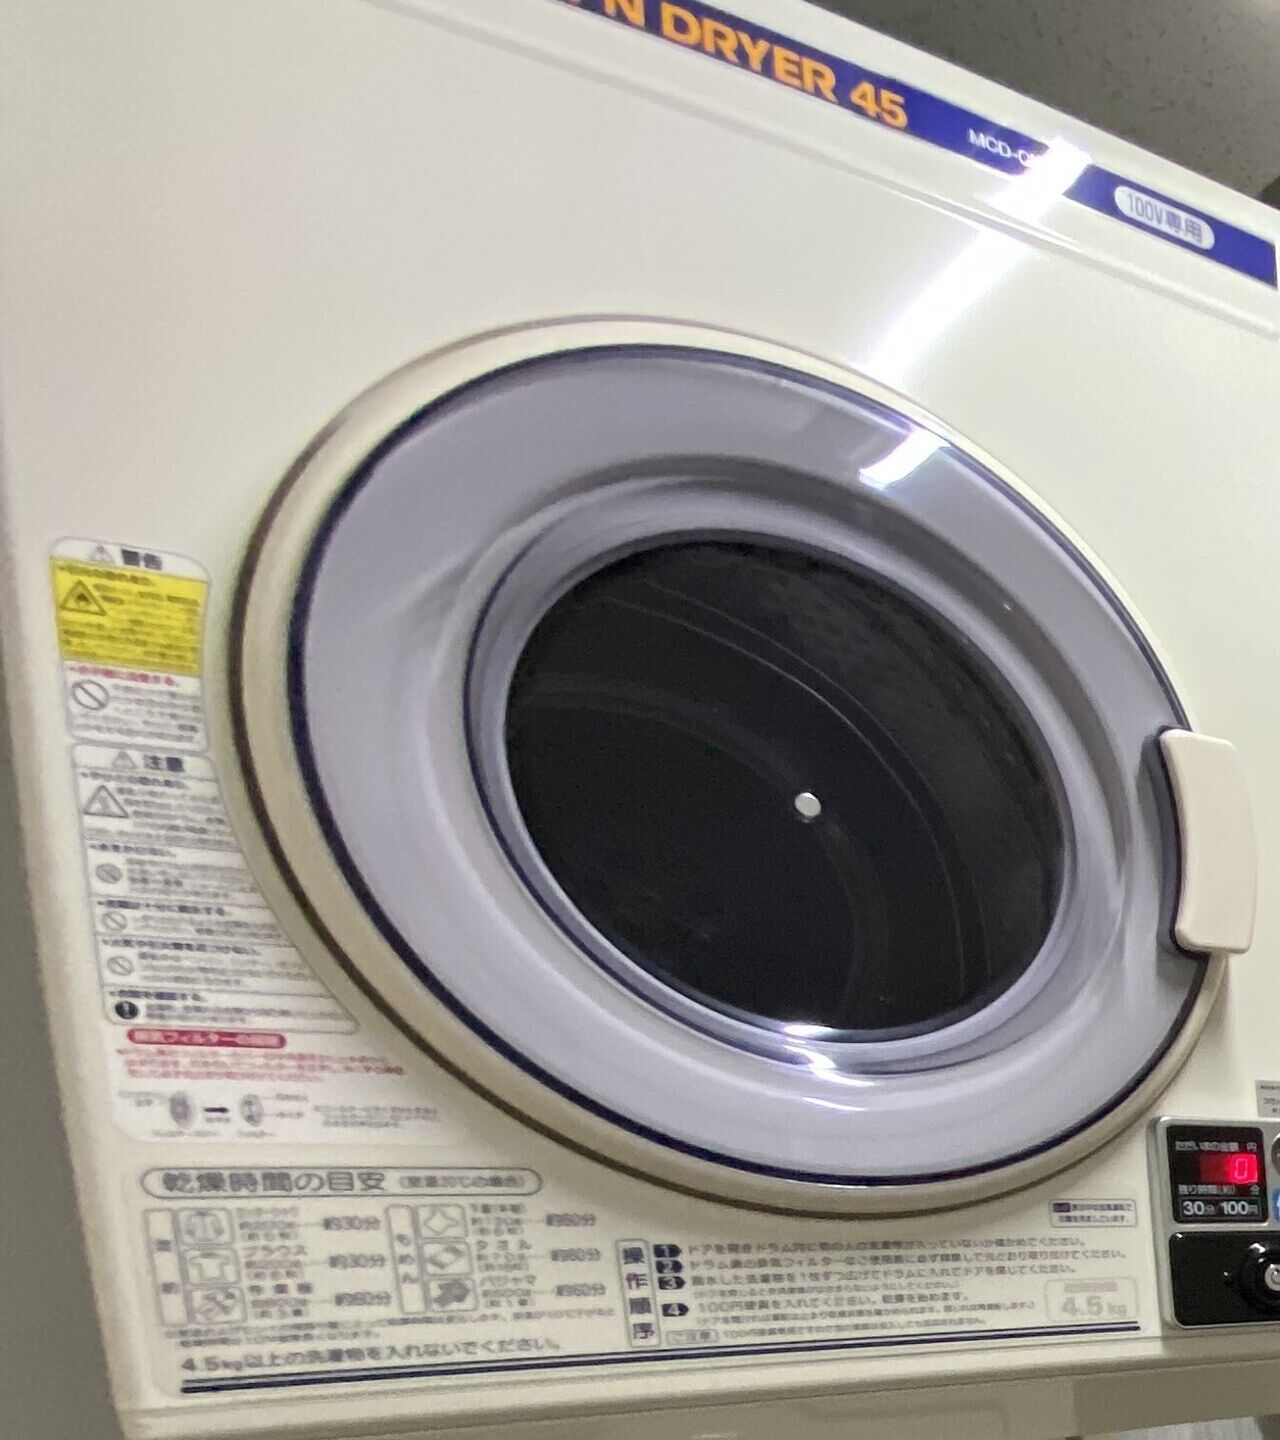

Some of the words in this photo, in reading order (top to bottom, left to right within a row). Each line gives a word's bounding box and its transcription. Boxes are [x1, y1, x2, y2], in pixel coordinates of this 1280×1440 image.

[660, 1, 839, 104] DRYER
[849, 81, 909, 129] 45
[1127, 191, 1206, 245] 100V専用
[162, 1171, 385, 1194] 乾燥時間の目安
